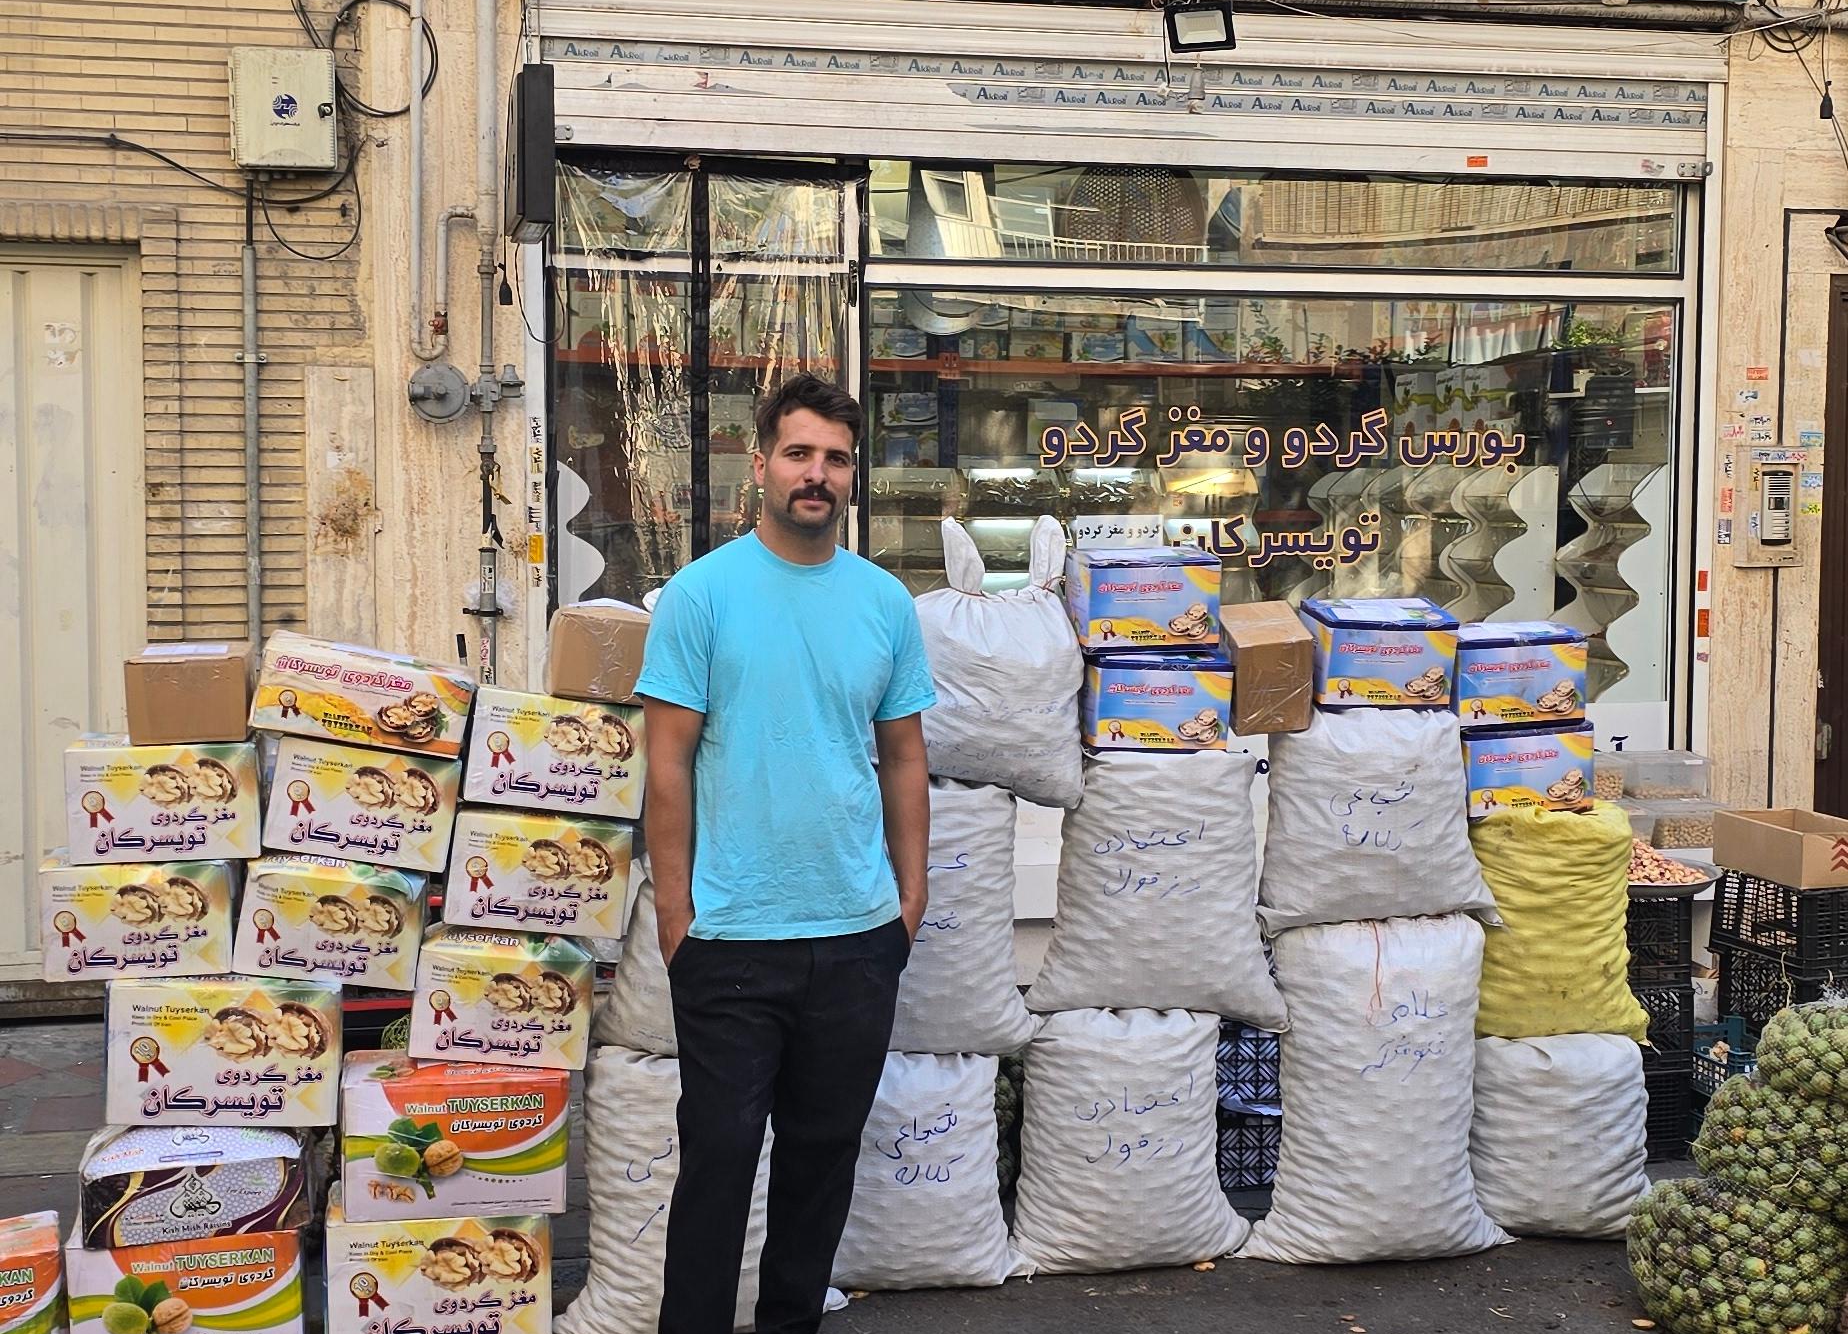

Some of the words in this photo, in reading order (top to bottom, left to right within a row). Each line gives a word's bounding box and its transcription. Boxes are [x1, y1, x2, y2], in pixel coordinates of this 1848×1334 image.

[1041, 406, 1147, 468] گردو
[1156, 404, 1233, 467] مغز
[1282, 407, 1390, 468] گردو
[1243, 425, 1271, 467] و
[1399, 427, 1525, 477] بورس
[276, 655, 341, 681] تویسرکان
[341, 670, 387, 688] گردوی
[388, 674, 413, 691] مغز
[550, 761, 602, 777] گردوی
[606, 765, 629, 780] مغز
[491, 770, 600, 804] تویسرکان
[152, 807, 207, 827] گردوی
[212, 808, 236, 824] مغز
[350, 813, 405, 829] گردوی
[407, 818, 432, 834] مغز
[95, 826, 207, 855] تویسرکان
[289, 819, 400, 854] تویسرکان
[528, 883, 582, 900] گردوی
[584, 887, 608, 903] مغز
[470, 894, 579, 927] تویسرکان
[122, 924, 178, 945] گردوی
[184, 926, 208, 942] مغز
[316, 938, 371, 954] گردوی
[374, 940, 399, 956] مغز
[67, 944, 178, 974] تویسرکان
[258, 946, 367, 977] تویسرکان
[132, 1004, 163, 1013] Walnut
[164, 1004, 210, 1015] Tuyserkan
[491, 1016, 545, 1033] گردوی
[547, 1019, 572, 1034] مغز
[435, 1027, 541, 1057] تویسرکان
[216, 1063, 287, 1086] گردوی
[292, 1066, 323, 1086] مغز
[142, 1086, 285, 1118] تویسرکان
[406, 1103, 447, 1116] Walnut
[447, 1093, 544, 1113] TUYSERKAN
[451, 1118, 504, 1133] تویسرکان
[509, 1114, 543, 1130] گردوی
[875, 1102, 958, 1160] شجاعی
[162, 1226, 180, 1235] Kish
[182, 1224, 200, 1233] Mish
[349, 1241, 380, 1250] Walnut
[381, 1238, 425, 1250] Tuyserkan
[131, 1261, 174, 1274] Walnut
[174, 1247, 275, 1272] TUYSERKAN
[179, 1273, 235, 1291] تویسرکان
[239, 1268, 275, 1284] گردوی
[434, 1290, 503, 1314] گردوی
[507, 1290, 537, 1311] مغز
